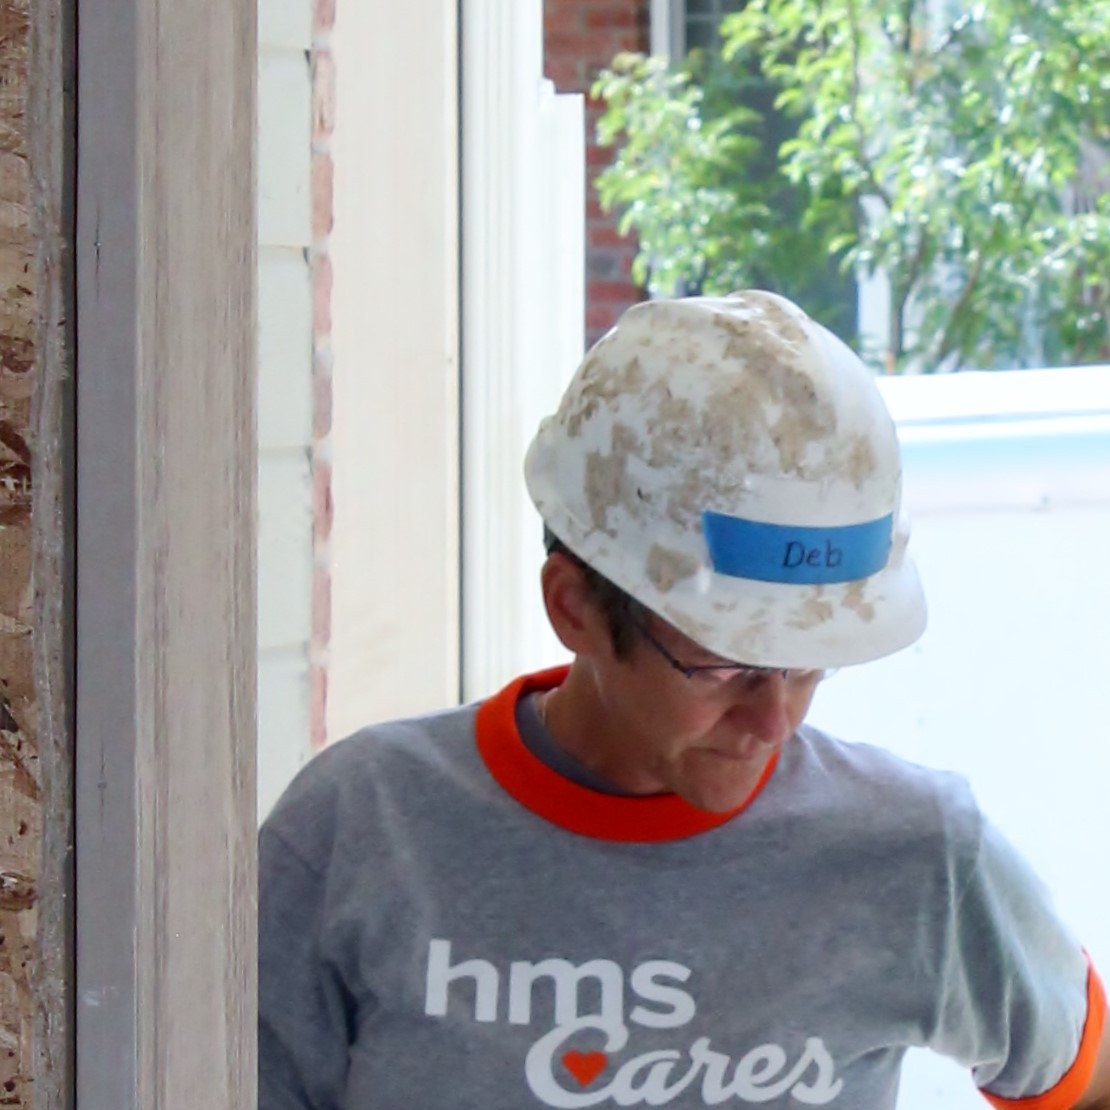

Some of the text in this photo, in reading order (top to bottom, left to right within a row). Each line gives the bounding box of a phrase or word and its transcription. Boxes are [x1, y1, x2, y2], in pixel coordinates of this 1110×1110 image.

[783, 539, 844, 569] Deb
[424, 938, 697, 1029] hms
[524, 1013, 845, 1110] Cares
